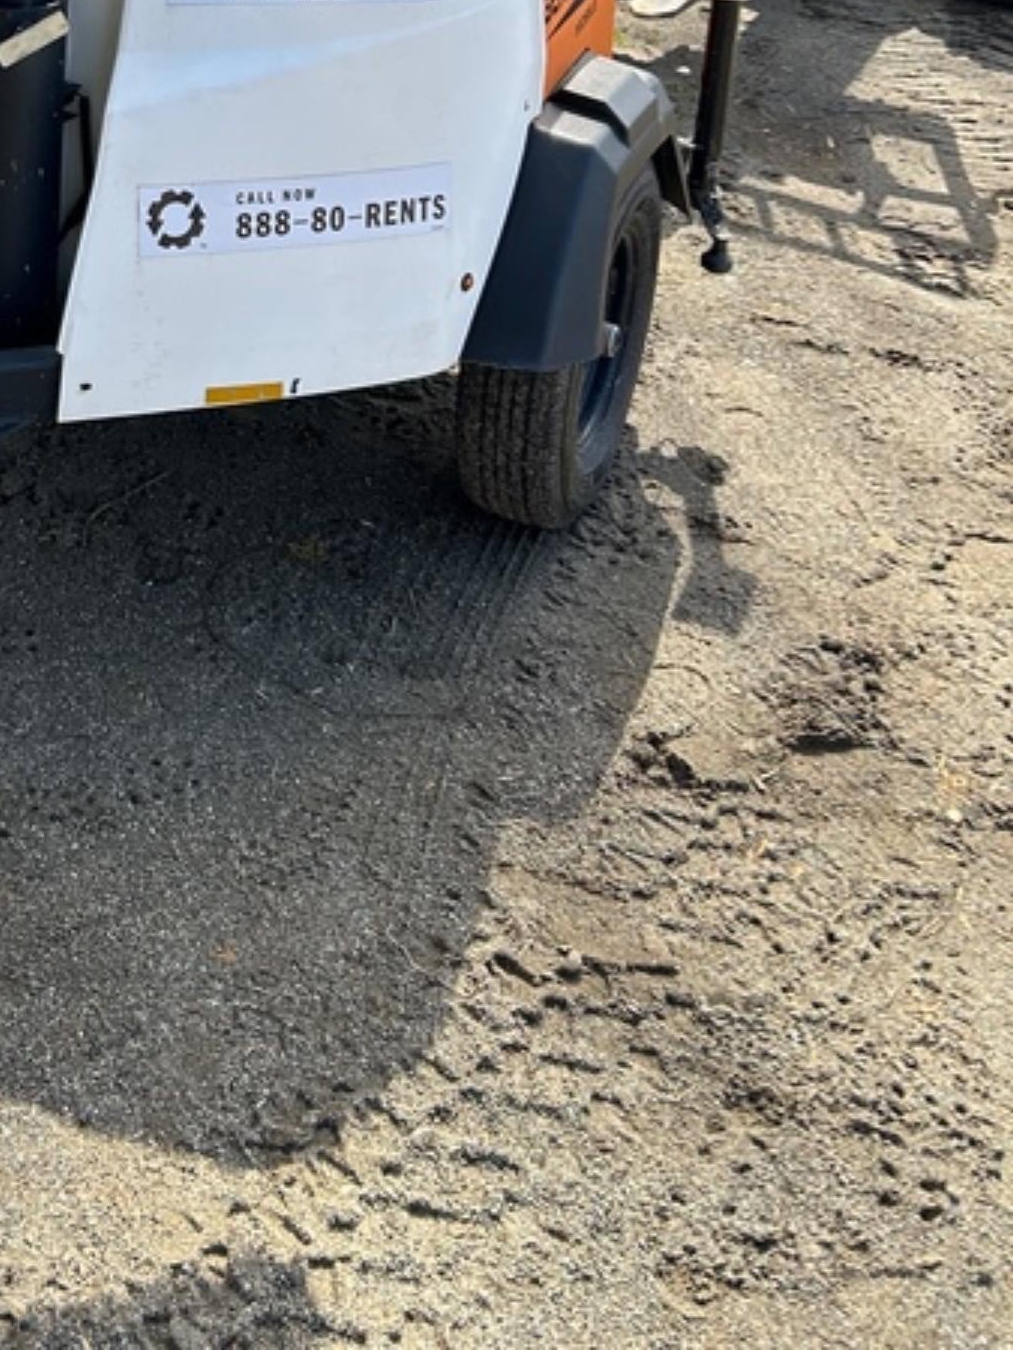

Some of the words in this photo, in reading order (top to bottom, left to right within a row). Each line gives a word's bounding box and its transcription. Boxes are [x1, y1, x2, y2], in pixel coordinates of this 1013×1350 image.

[236, 191, 275, 205] CALL
[283, 188, 316, 202] NOW
[236, 194, 446, 238] 888-80-RENTS
